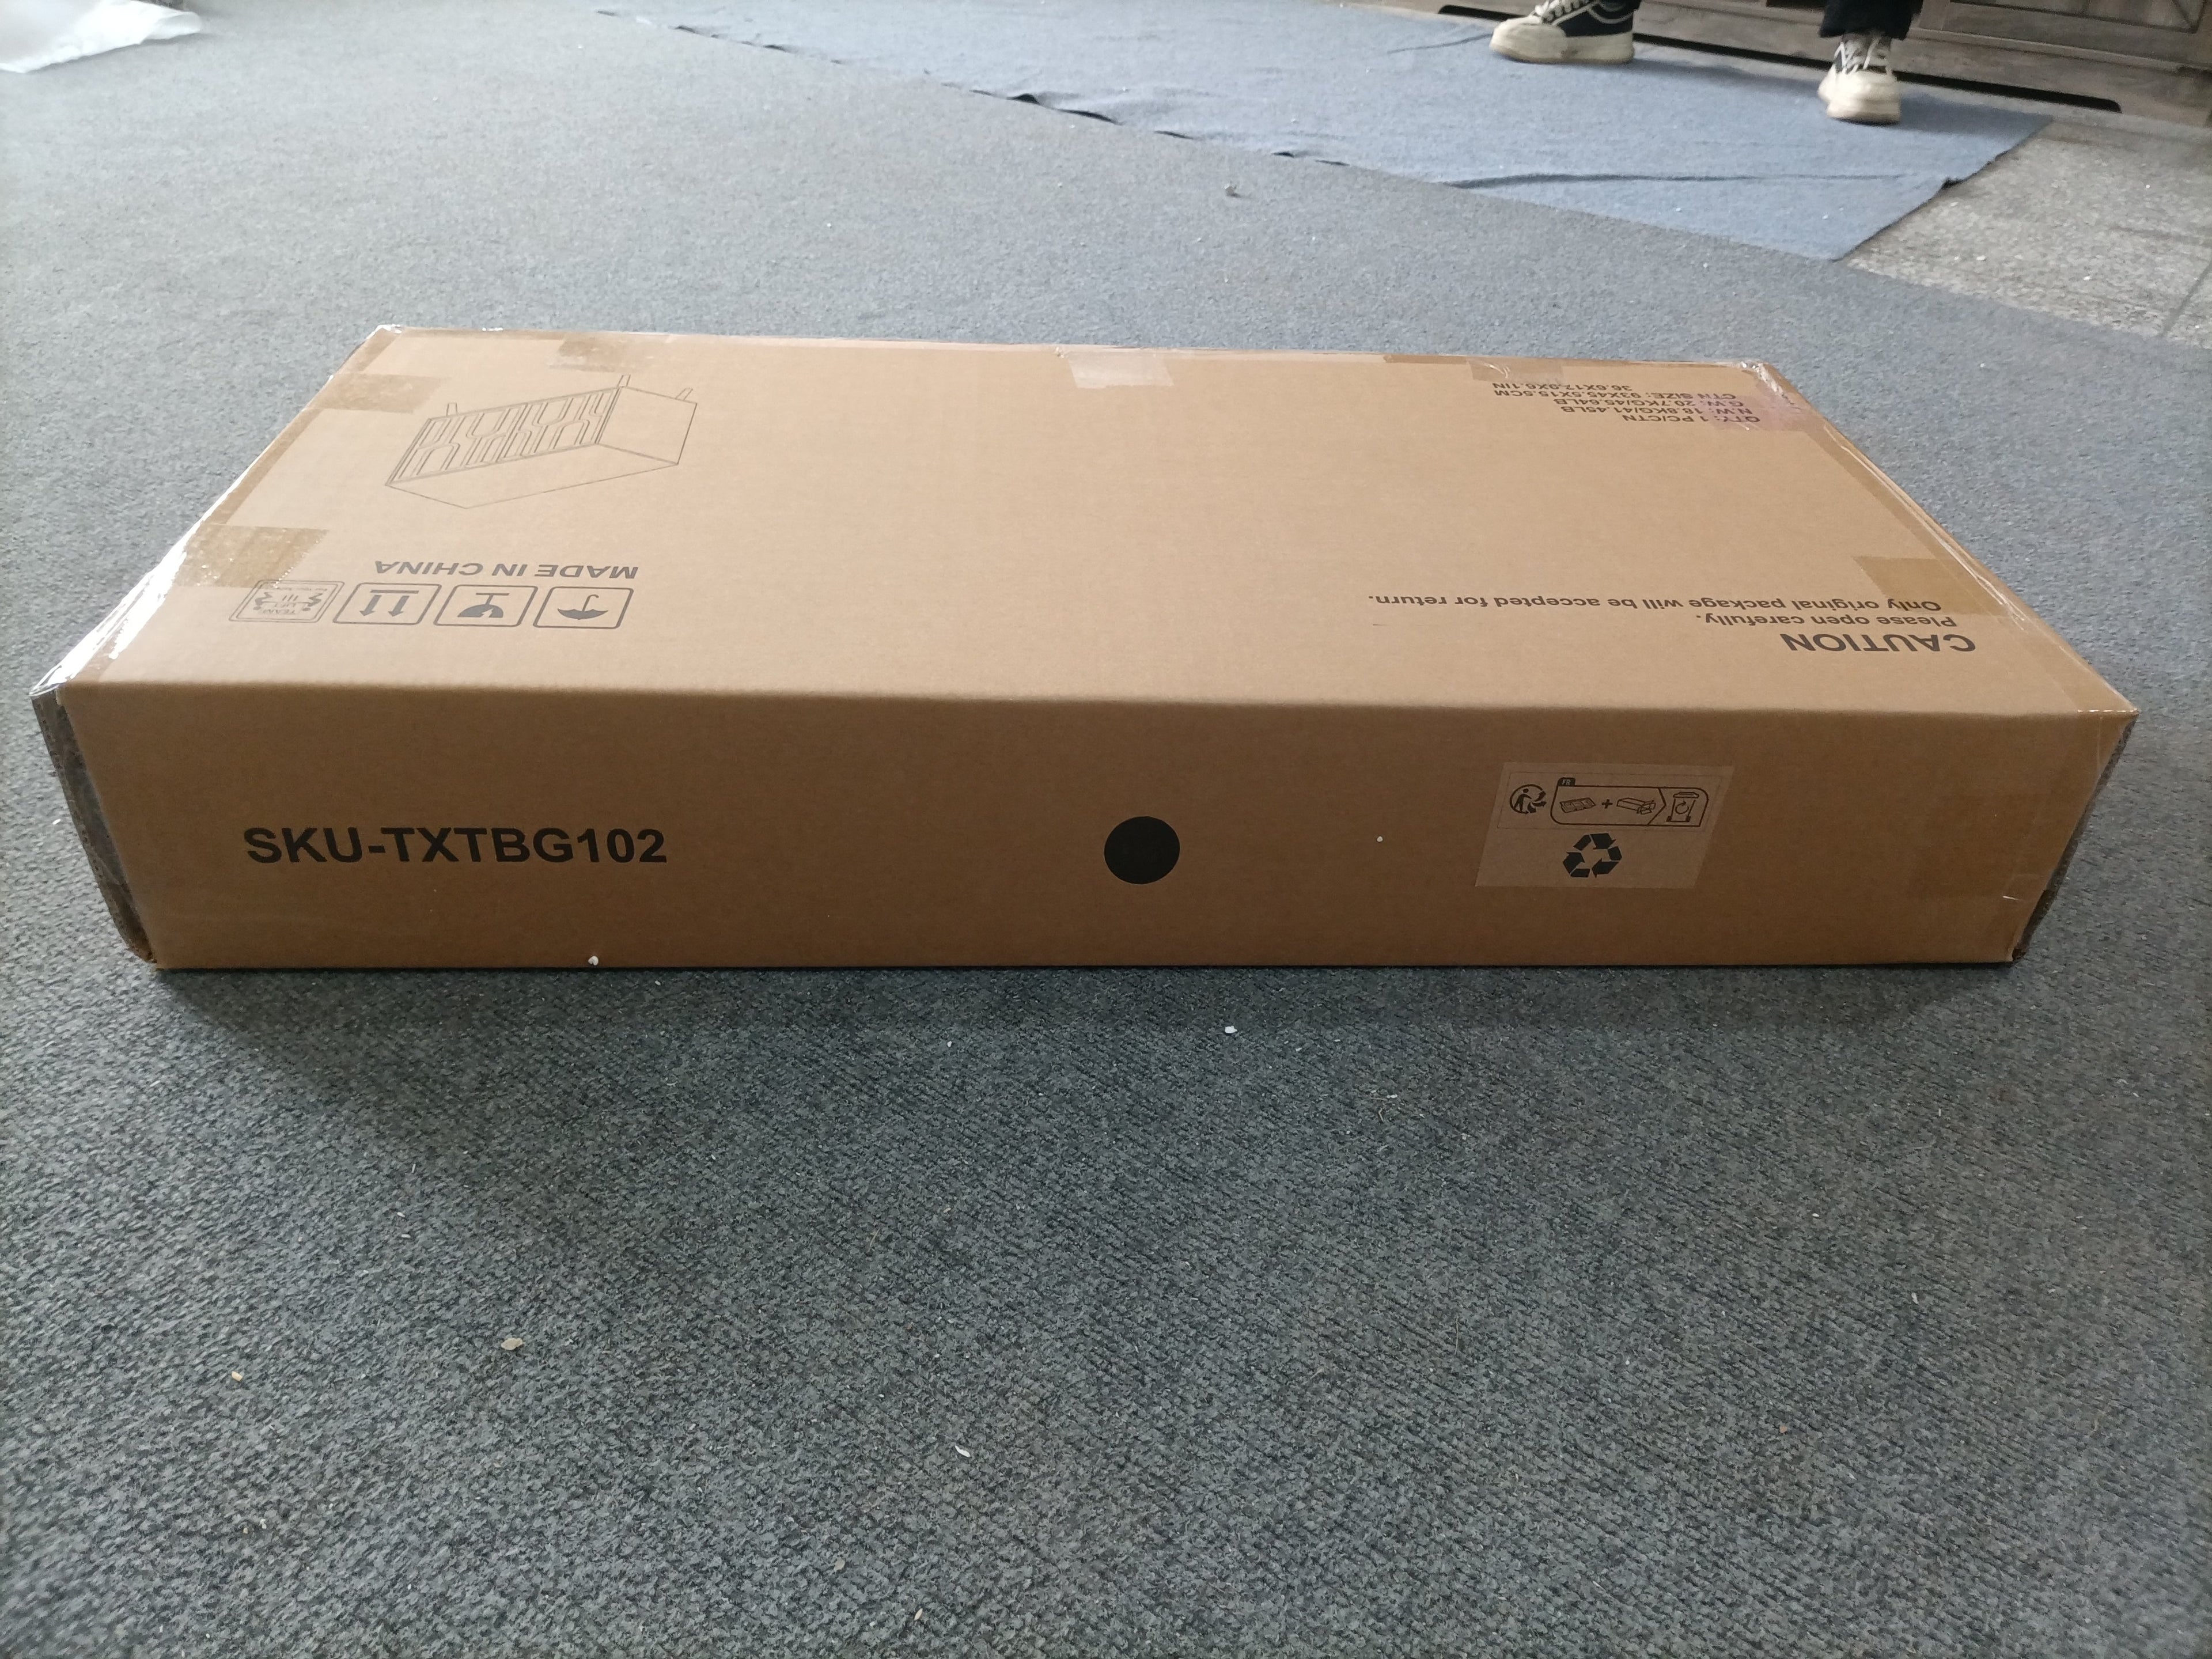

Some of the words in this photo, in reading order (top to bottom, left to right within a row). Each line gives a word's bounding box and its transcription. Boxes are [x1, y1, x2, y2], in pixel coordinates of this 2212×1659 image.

[1560, 406, 1703, 414] 18.8KG/41.45LB
[374, 560, 483, 575] CHINA
[492, 563, 527, 577] IN
[535, 564, 639, 579] MADE
[1368, 596, 1448, 605] return.
[1455, 596, 1489, 607] for
[1494, 597, 1601, 607] accepted
[1607, 598, 1638, 609] be
[1642, 599, 1683, 609] will
[1689, 598, 1786, 609] package
[1791, 599, 1880, 611] original
[1888, 598, 1942, 611] Only
[1696, 613, 1805, 625] carefully.
[1810, 615, 1870, 625] open
[1877, 616, 1958, 627] Please
[1779, 634, 1976, 652] CAUTION
[243, 827, 667, 863] SKU-TXTBG102
